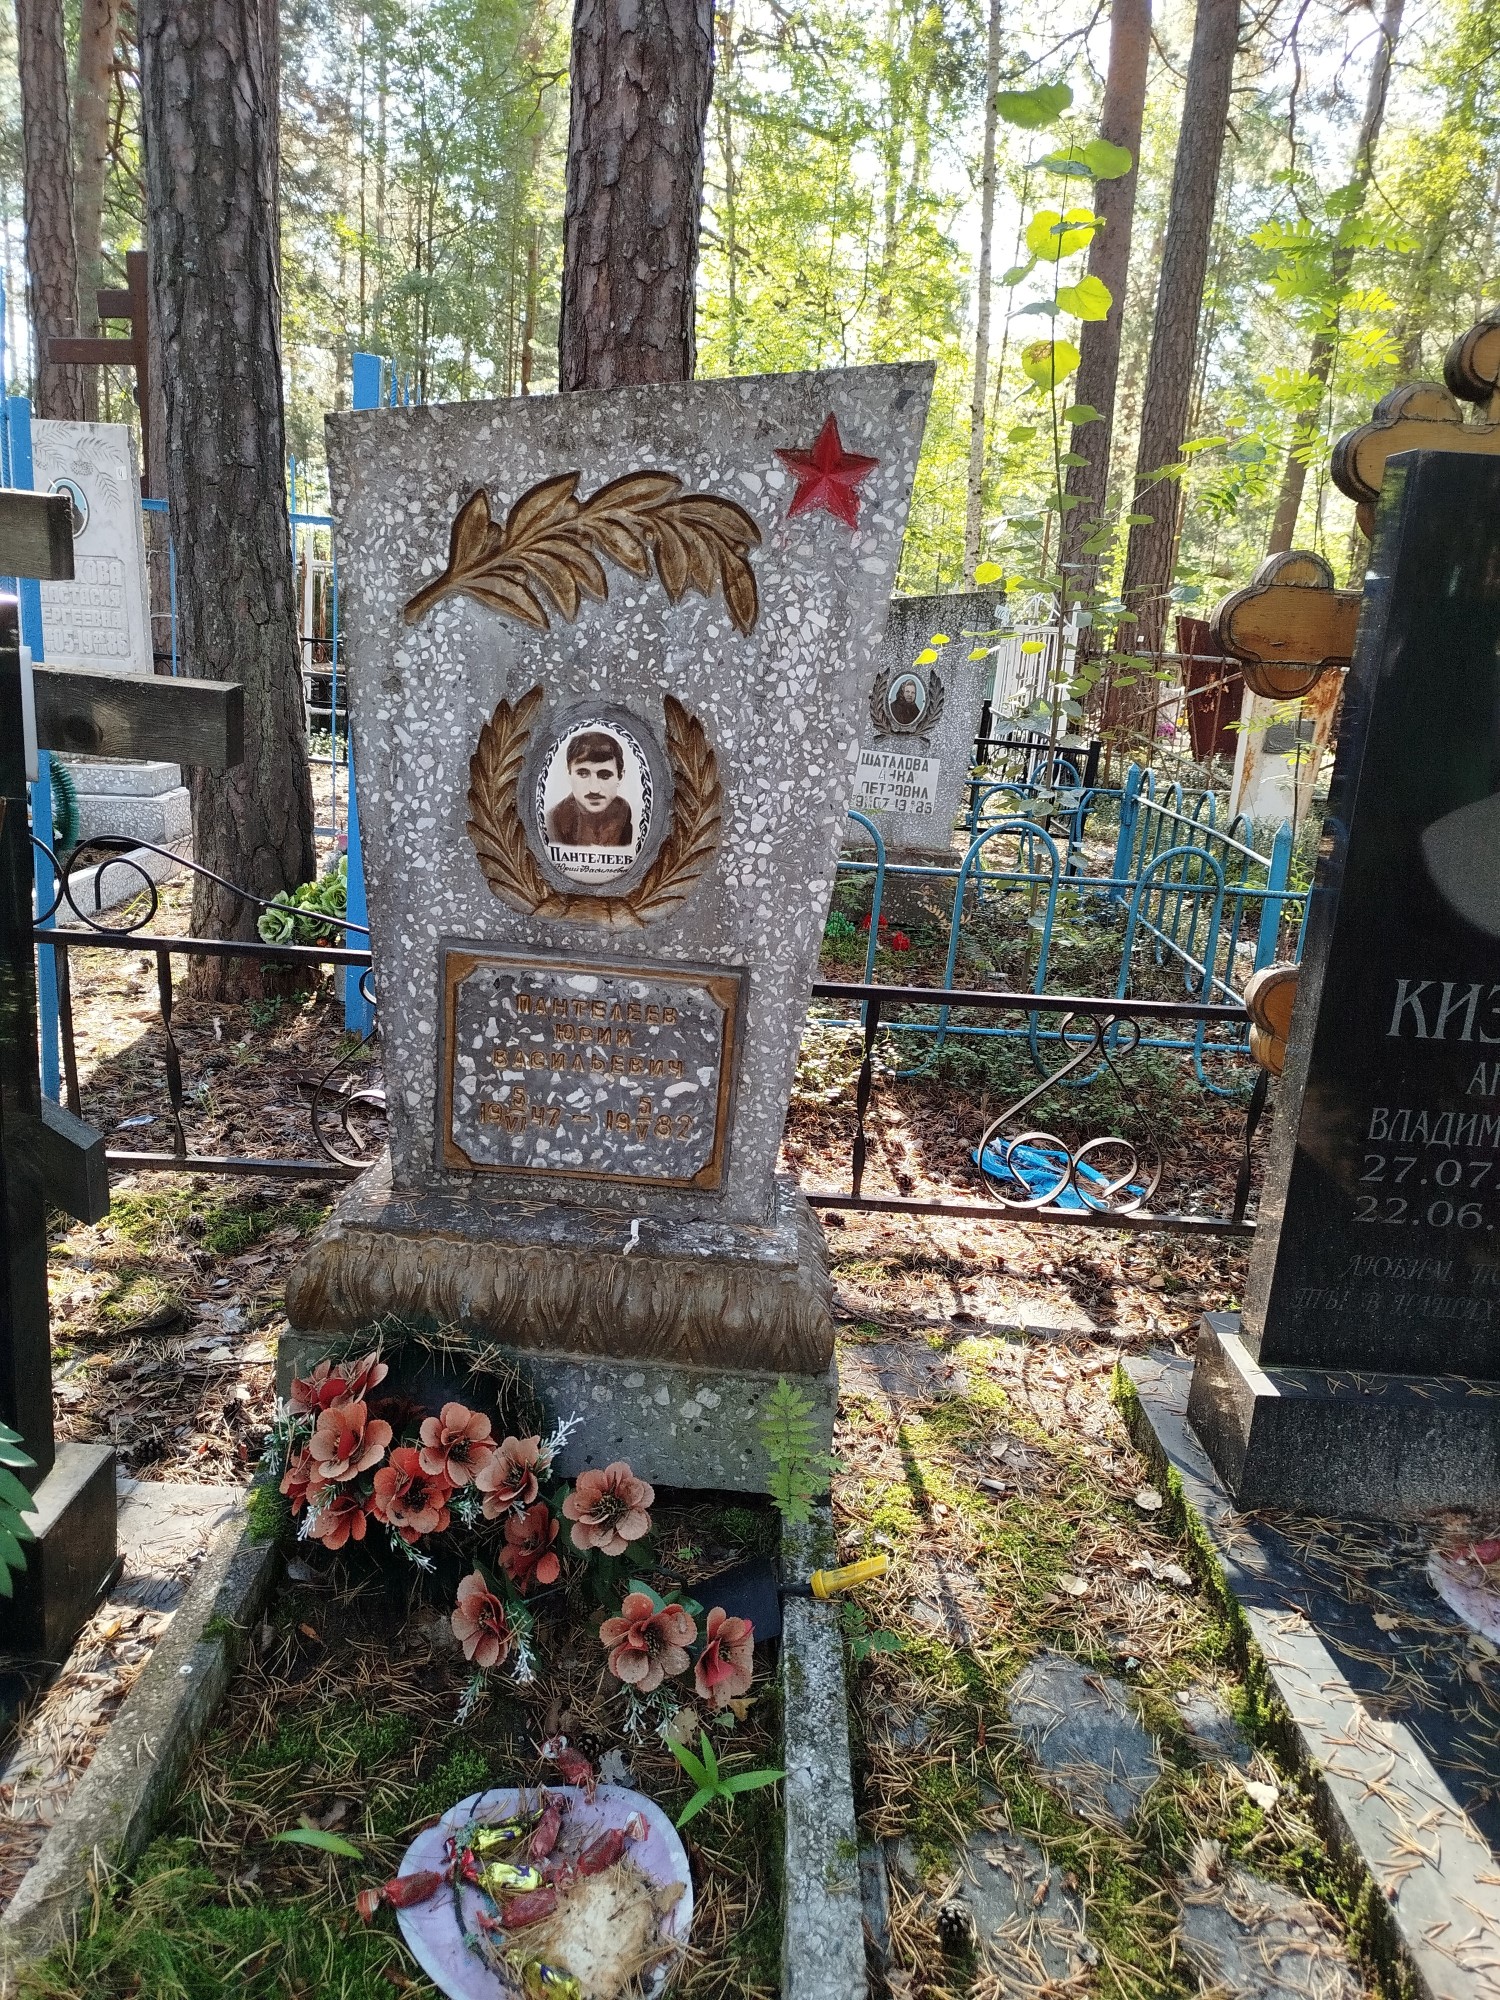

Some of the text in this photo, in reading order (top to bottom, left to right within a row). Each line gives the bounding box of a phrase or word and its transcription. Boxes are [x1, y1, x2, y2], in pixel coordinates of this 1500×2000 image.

[74, 560, 122, 586] КОВА
[42, 607, 121, 628] ЕРГЕЕВНА
[861, 753, 929, 772] ШАТАЛОВА
[550, 846, 633, 865] ПАНТЕЛЕЕВ
[516, 993, 678, 1026] ПАНТЕЛЕЕВ
[493, 1049, 684, 1079] ВАСИЛЬЕВИЧ
